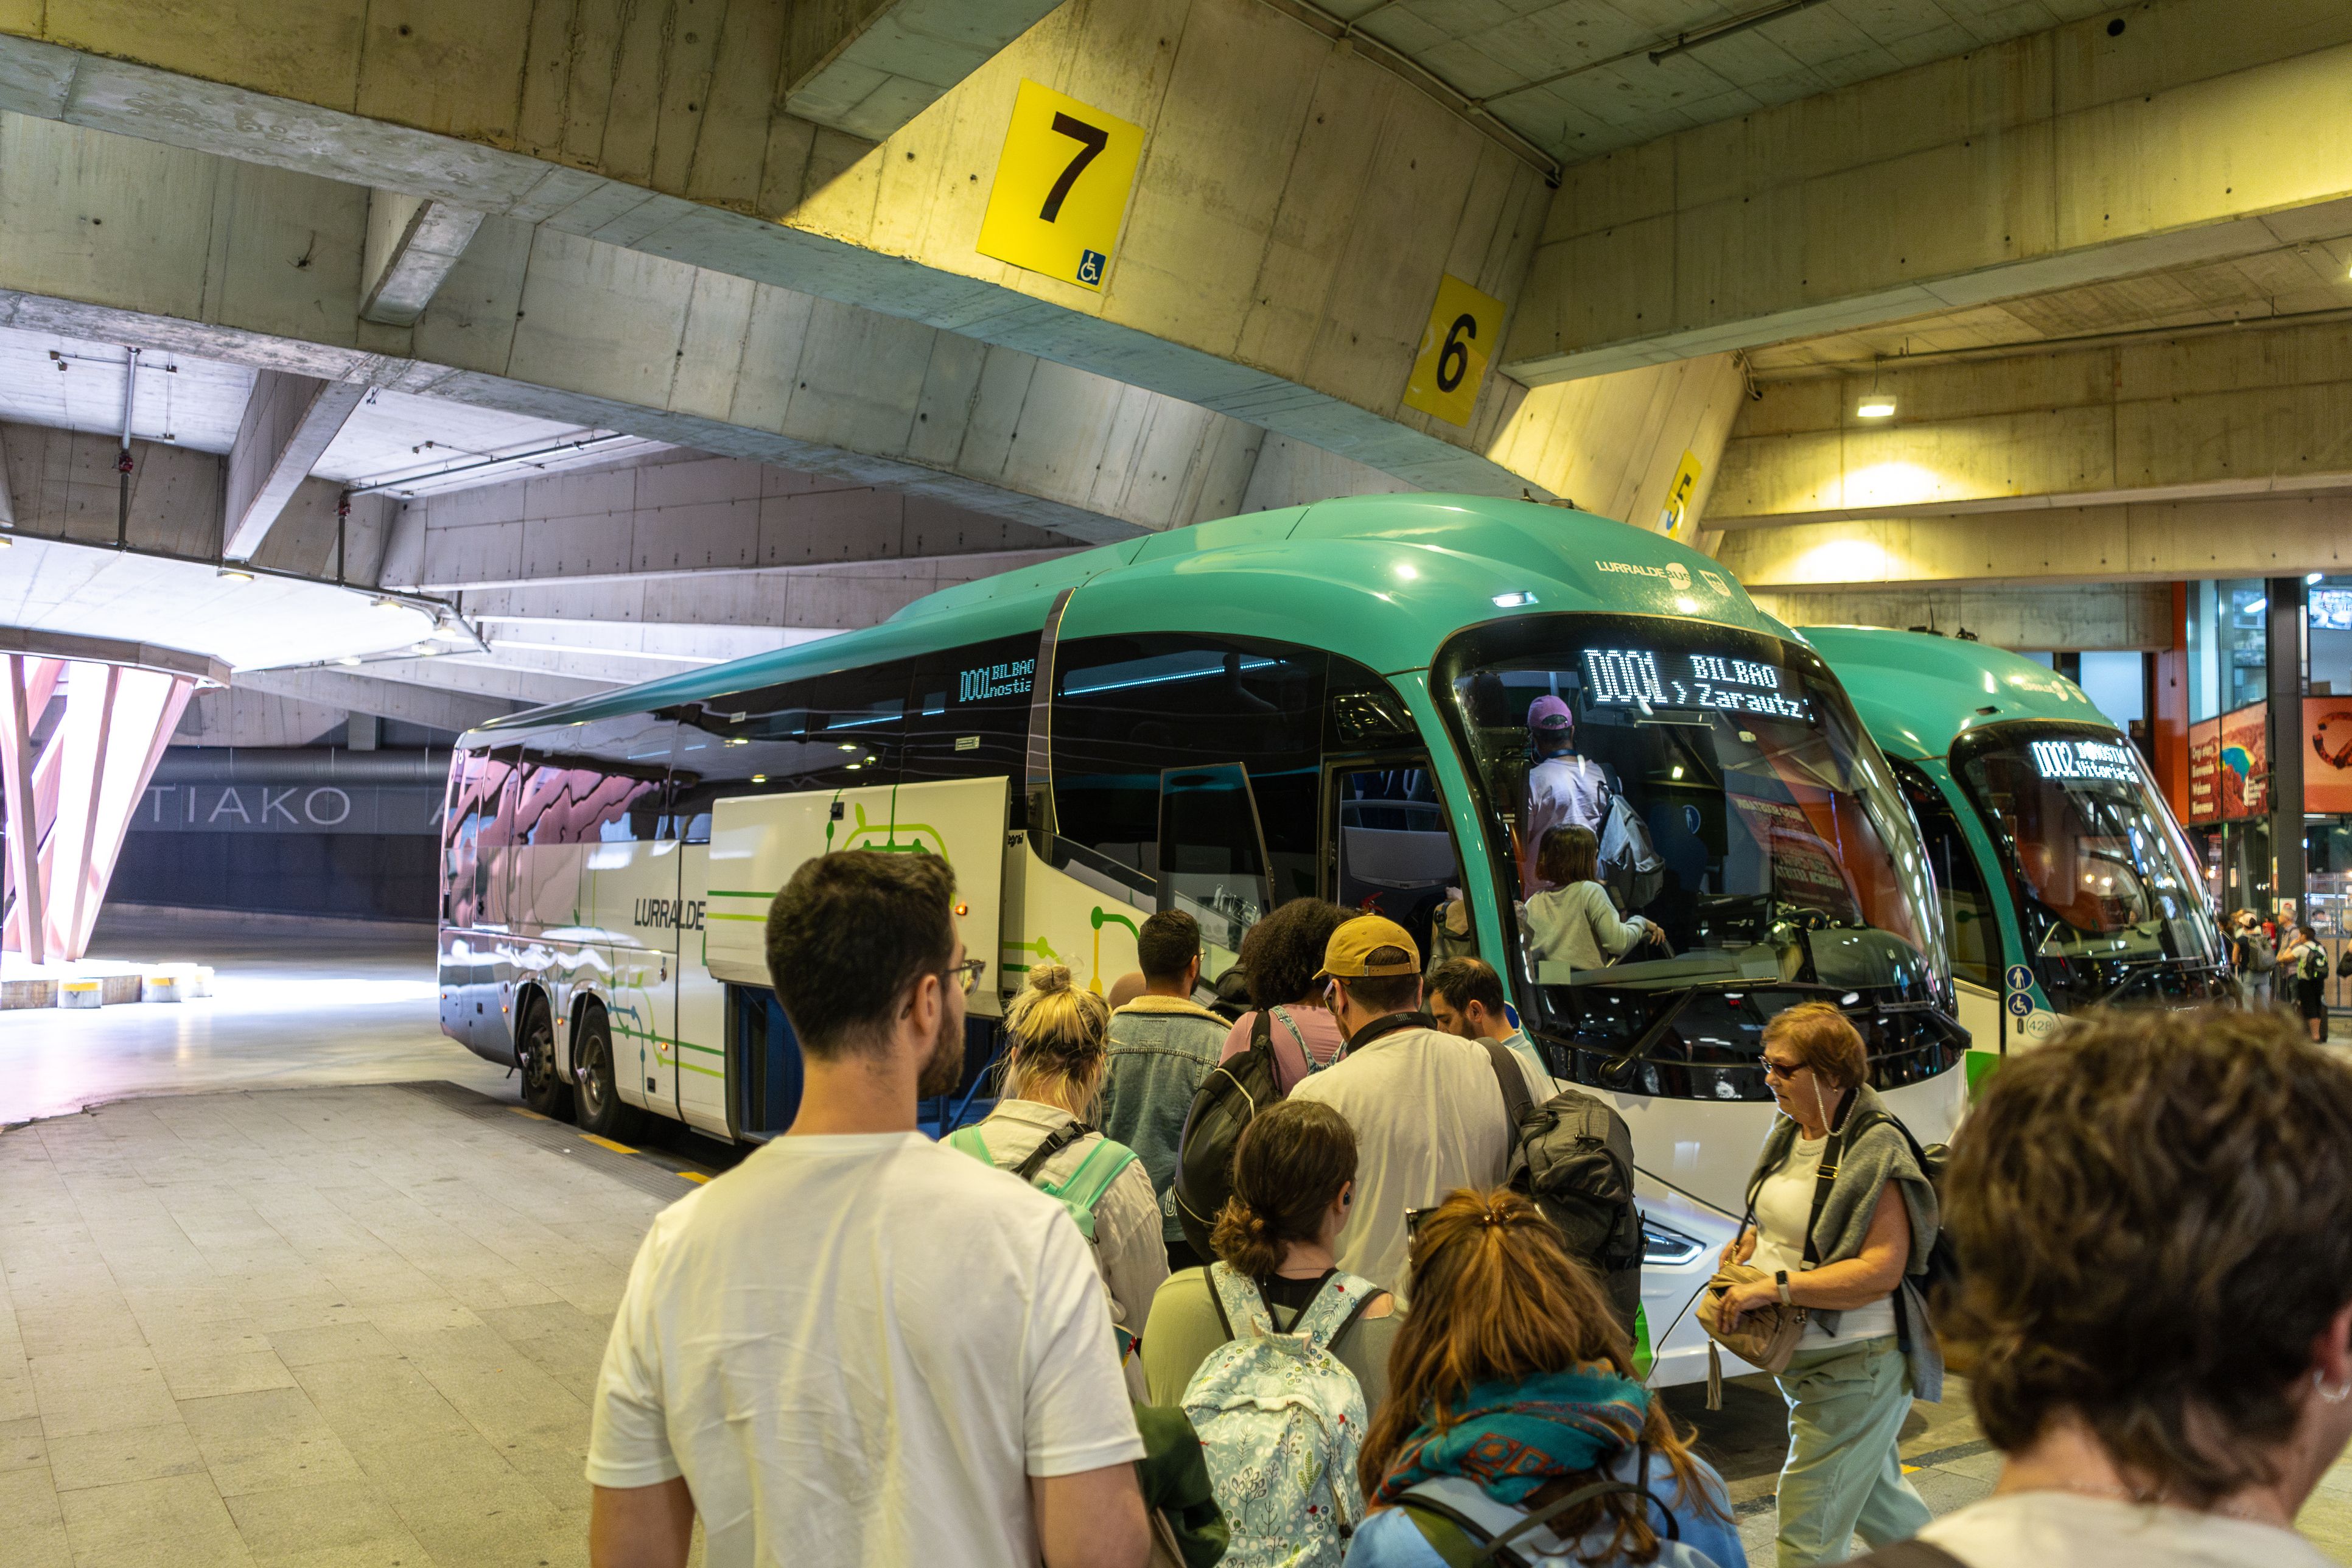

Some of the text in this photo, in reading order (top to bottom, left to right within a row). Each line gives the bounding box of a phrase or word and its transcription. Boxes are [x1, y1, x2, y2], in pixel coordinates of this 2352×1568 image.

[1039, 111, 1109, 223] 7
[1437, 313, 1477, 393] 6
[959, 659, 1035, 702] D001 BILBAO
[1584, 649, 1778, 704] D001 BILBAO
[1694, 682, 1804, 718] Zarautz
[634, 898, 706, 931] LURRALDE
